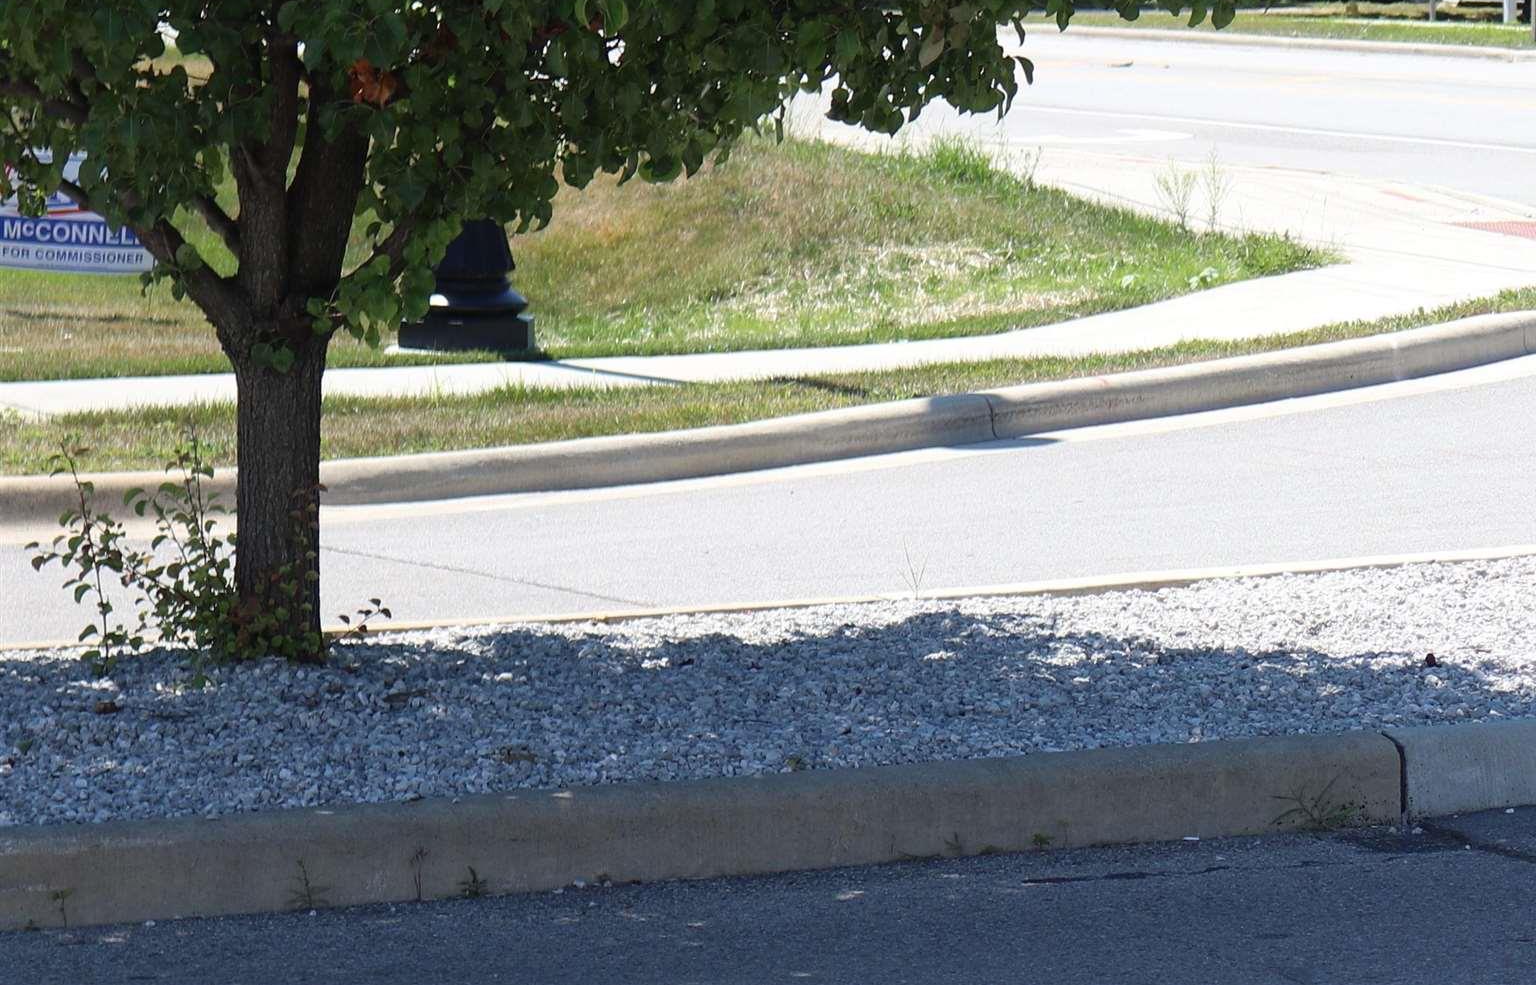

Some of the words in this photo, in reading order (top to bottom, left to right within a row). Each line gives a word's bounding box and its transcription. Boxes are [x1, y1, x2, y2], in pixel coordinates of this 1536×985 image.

[4, 219, 140, 245] McCONNEL
[3, 247, 30, 259] FOR
[35, 248, 143, 264] COMMISSIONER
